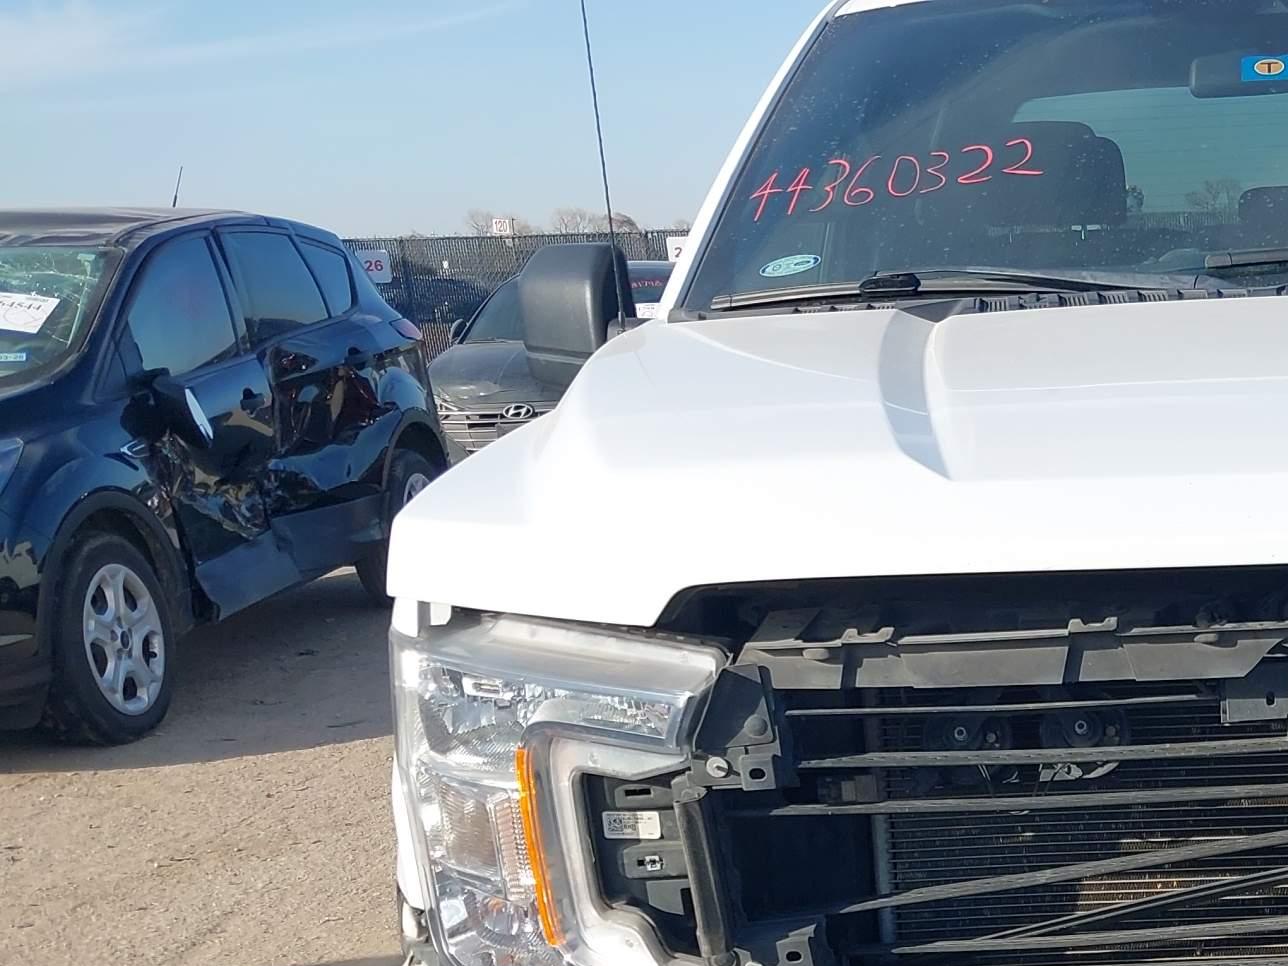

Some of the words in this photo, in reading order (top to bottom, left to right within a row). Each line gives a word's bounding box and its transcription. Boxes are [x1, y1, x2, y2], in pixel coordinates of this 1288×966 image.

[750, 138, 1044, 222] 44360322
[494, 220, 508, 232] 120
[364, 259, 384, 272] 26
